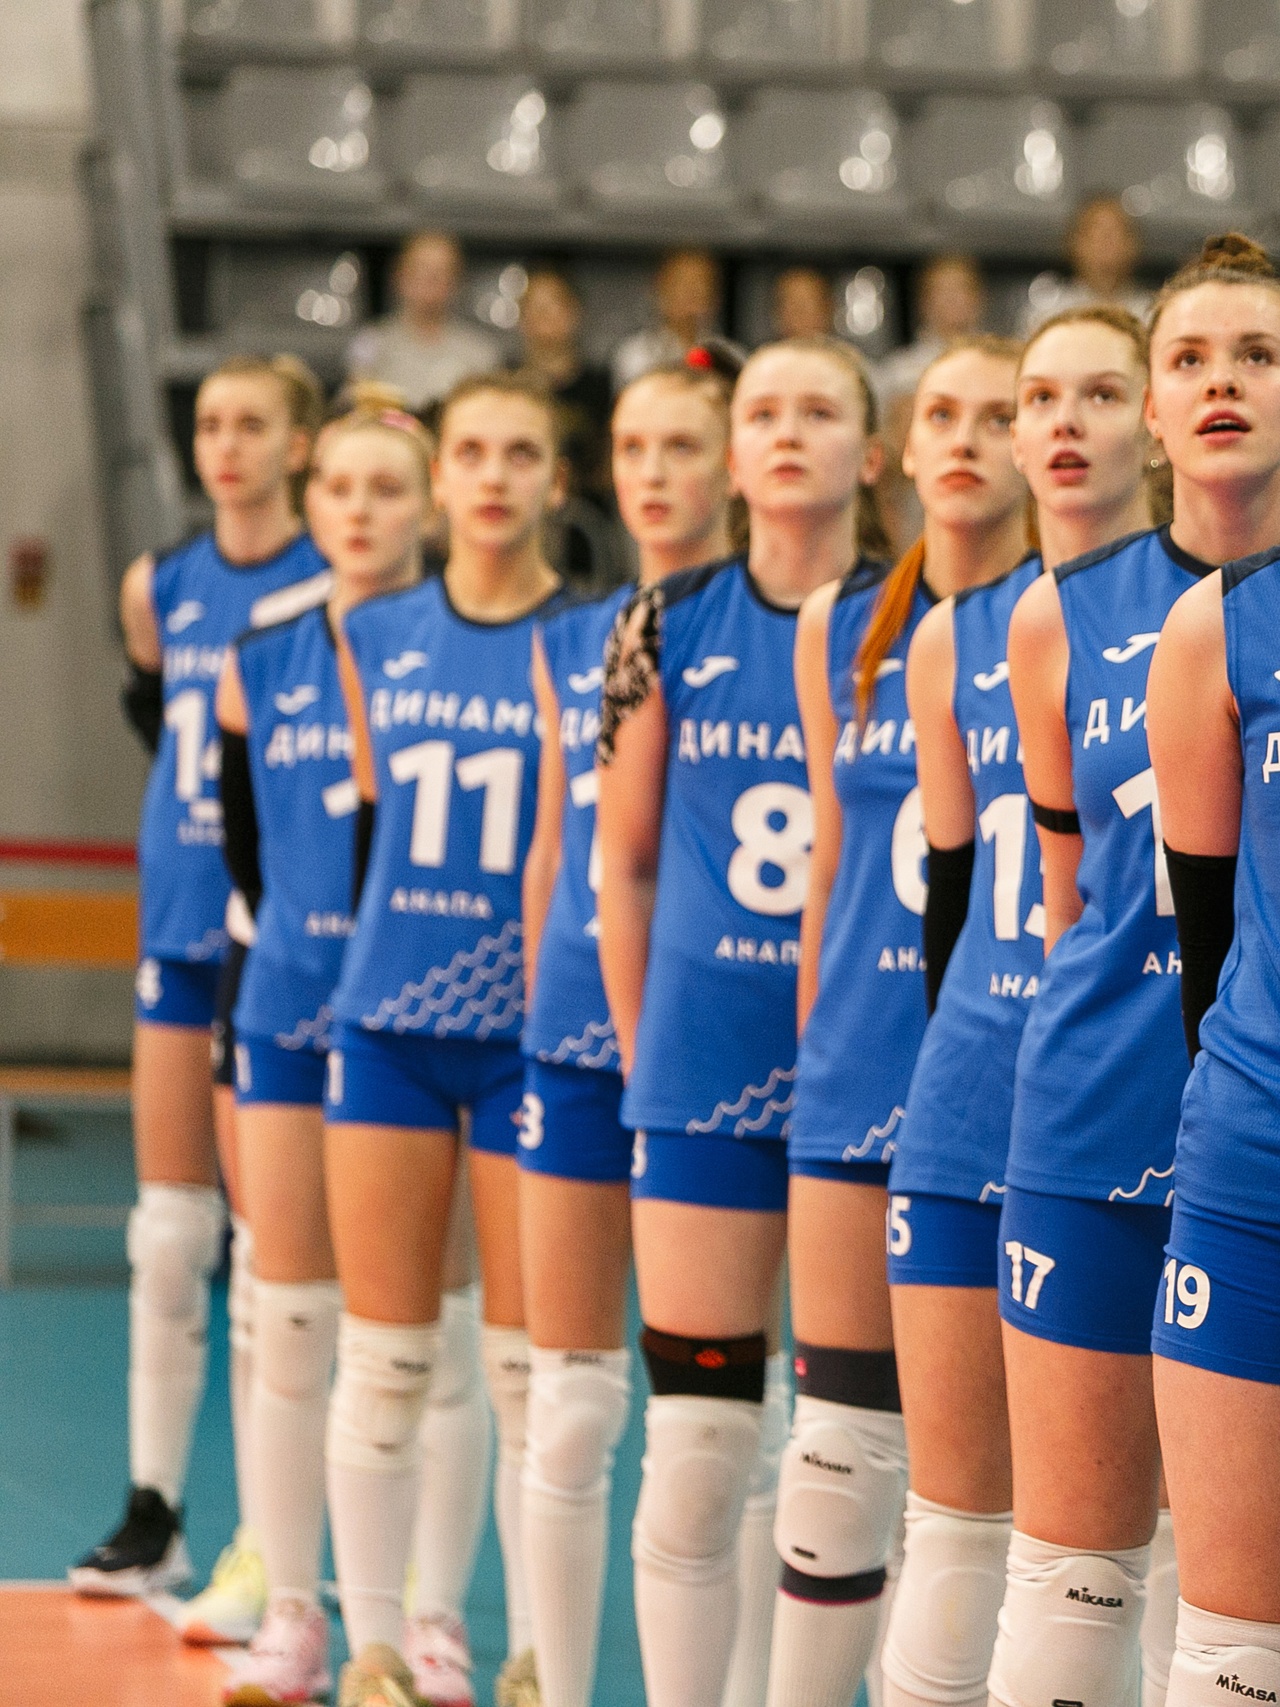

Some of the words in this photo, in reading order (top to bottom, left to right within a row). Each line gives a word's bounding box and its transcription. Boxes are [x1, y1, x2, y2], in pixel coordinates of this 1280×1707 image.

[388, 740, 524, 876] 11
[727, 781, 814, 917] 8
[978, 793, 1048, 942] 1
[887, 1195, 912, 1256] 5
[1005, 1238, 1056, 1311] 17
[1163, 1258, 1211, 1331] 19
[1066, 1587, 1123, 1608] MIKASA
[1216, 1673, 1277, 1703] MIKASA
